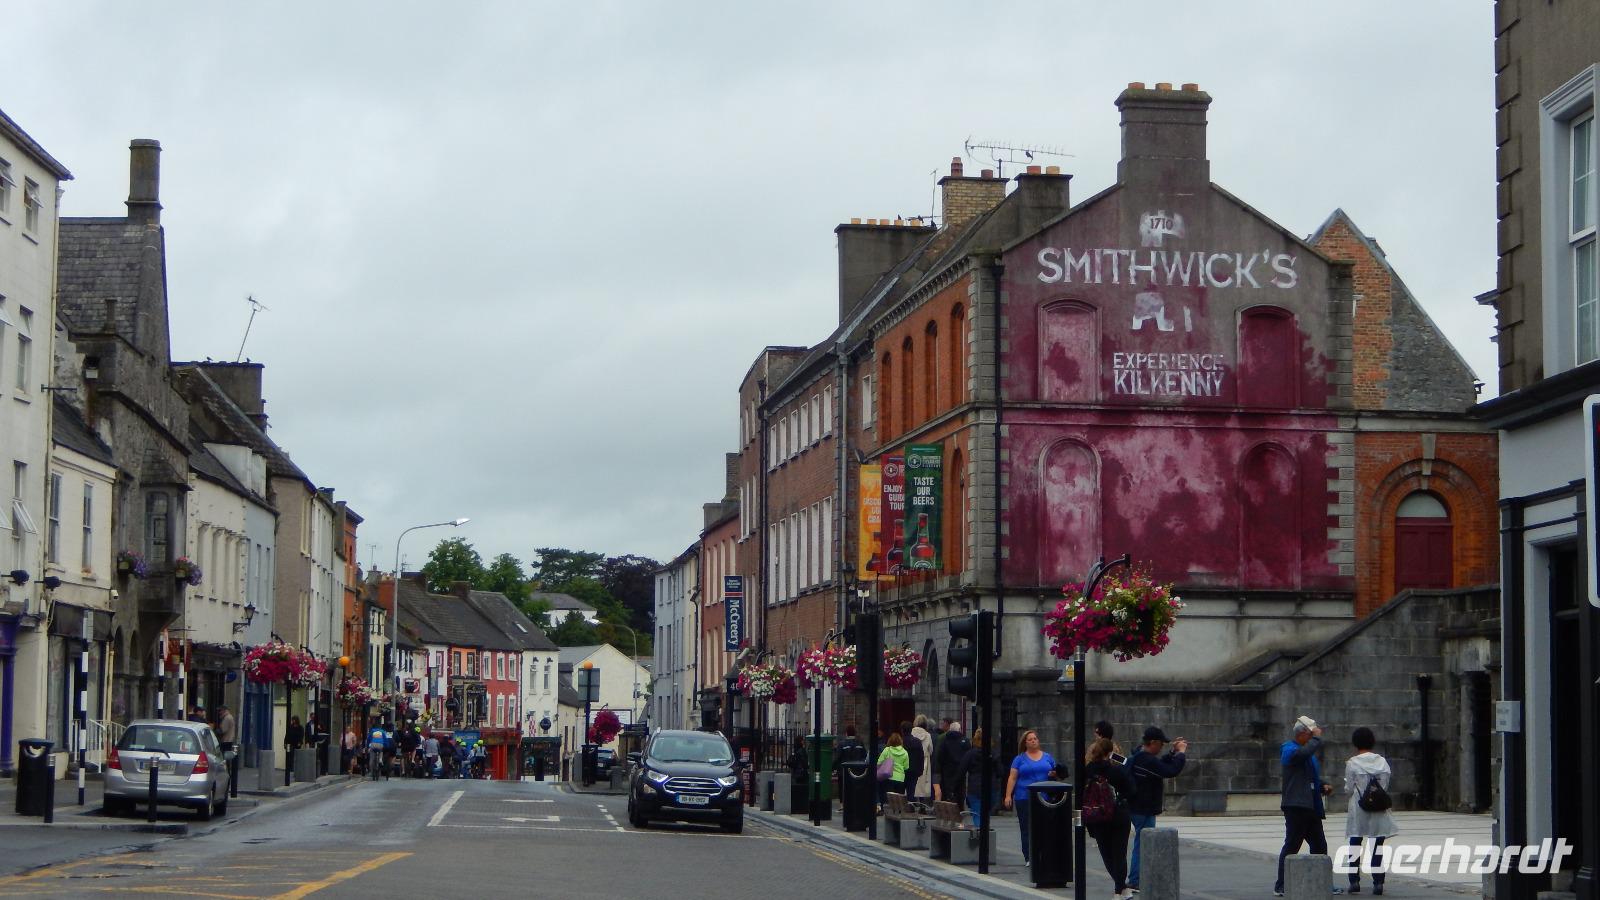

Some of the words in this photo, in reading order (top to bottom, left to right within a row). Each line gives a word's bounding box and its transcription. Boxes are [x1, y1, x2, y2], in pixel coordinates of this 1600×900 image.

[1150, 217, 1173, 230] 1710
[1037, 247, 1298, 289] SMITHWICK'S
[1113, 352, 1224, 370] EXPERIENCE
[1114, 369, 1225, 396] KILKENNY
[914, 477, 934, 486] TASTE
[884, 485, 902, 493] ENJOY
[917, 487, 930, 495] OUR
[913, 496, 934, 505] BEERS
[728, 599, 740, 646] McCreery
